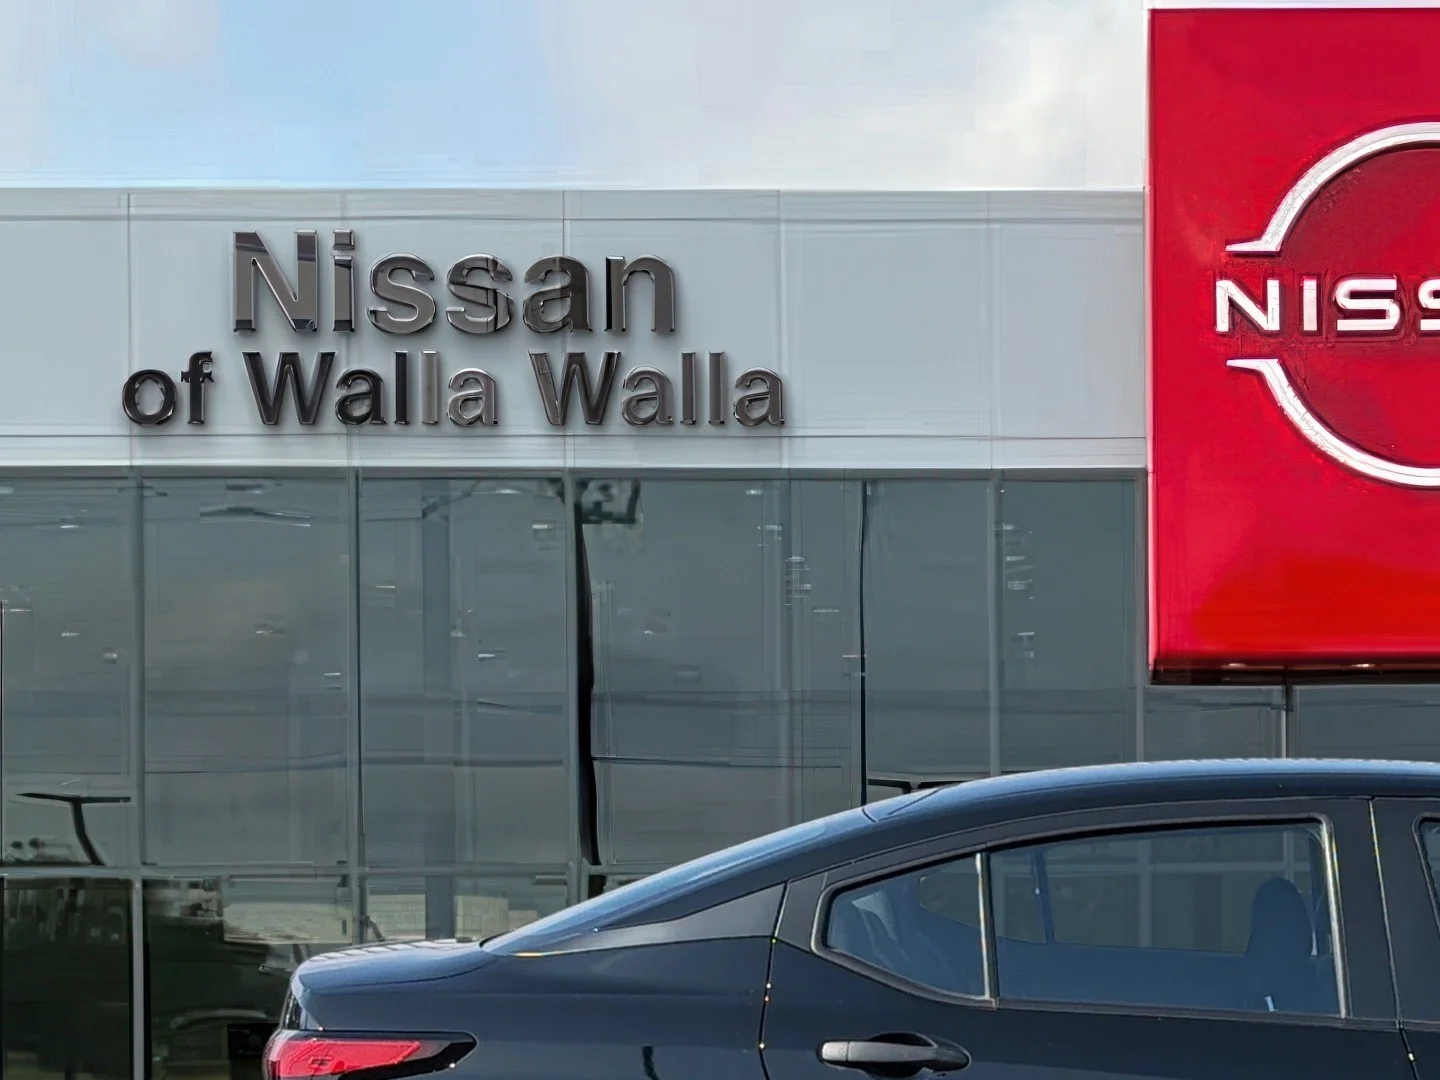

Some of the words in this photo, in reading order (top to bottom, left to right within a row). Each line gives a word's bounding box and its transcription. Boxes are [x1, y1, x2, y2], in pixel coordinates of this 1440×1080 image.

[231, 228, 677, 334] Nissan
[121, 350, 215, 426] of
[241, 350, 501, 427] Walla
[527, 350, 786, 428] Walla
